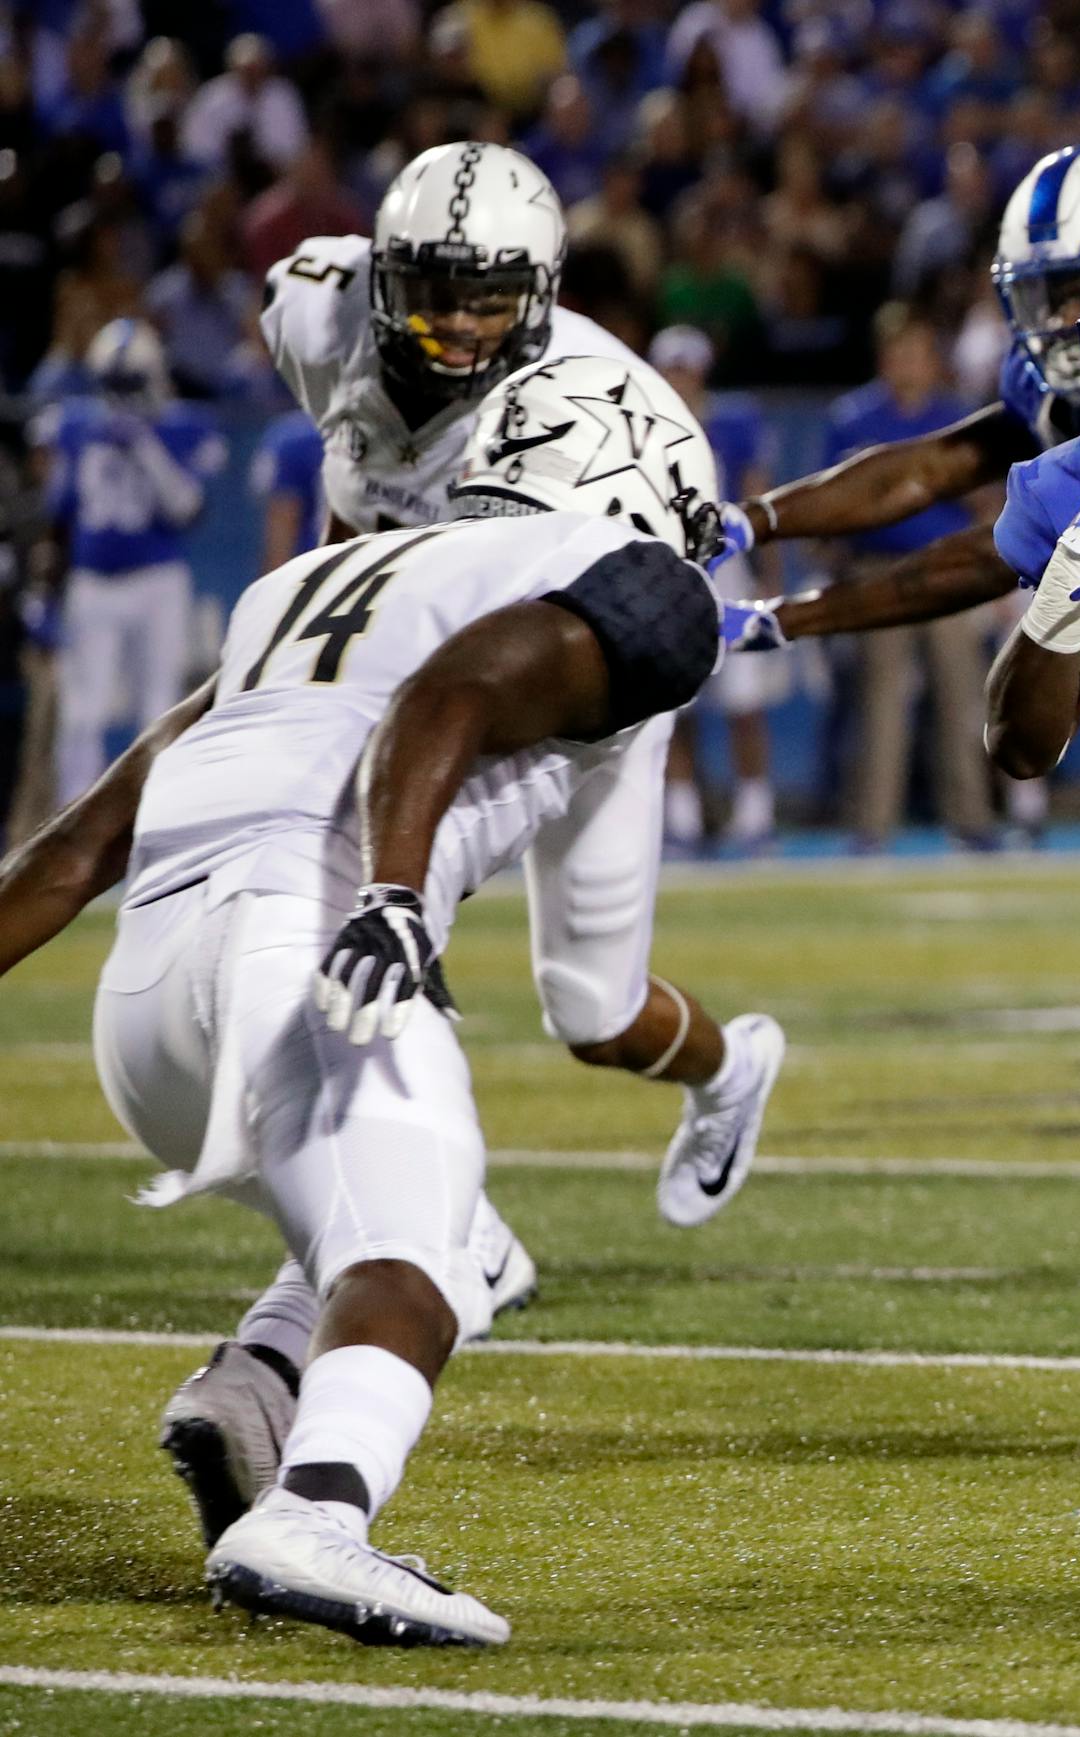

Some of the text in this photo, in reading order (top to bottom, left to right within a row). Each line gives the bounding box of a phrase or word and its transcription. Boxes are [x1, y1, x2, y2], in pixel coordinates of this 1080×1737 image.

[286, 256, 355, 291] 5
[619, 409, 656, 460] V
[238, 530, 450, 693] 14
